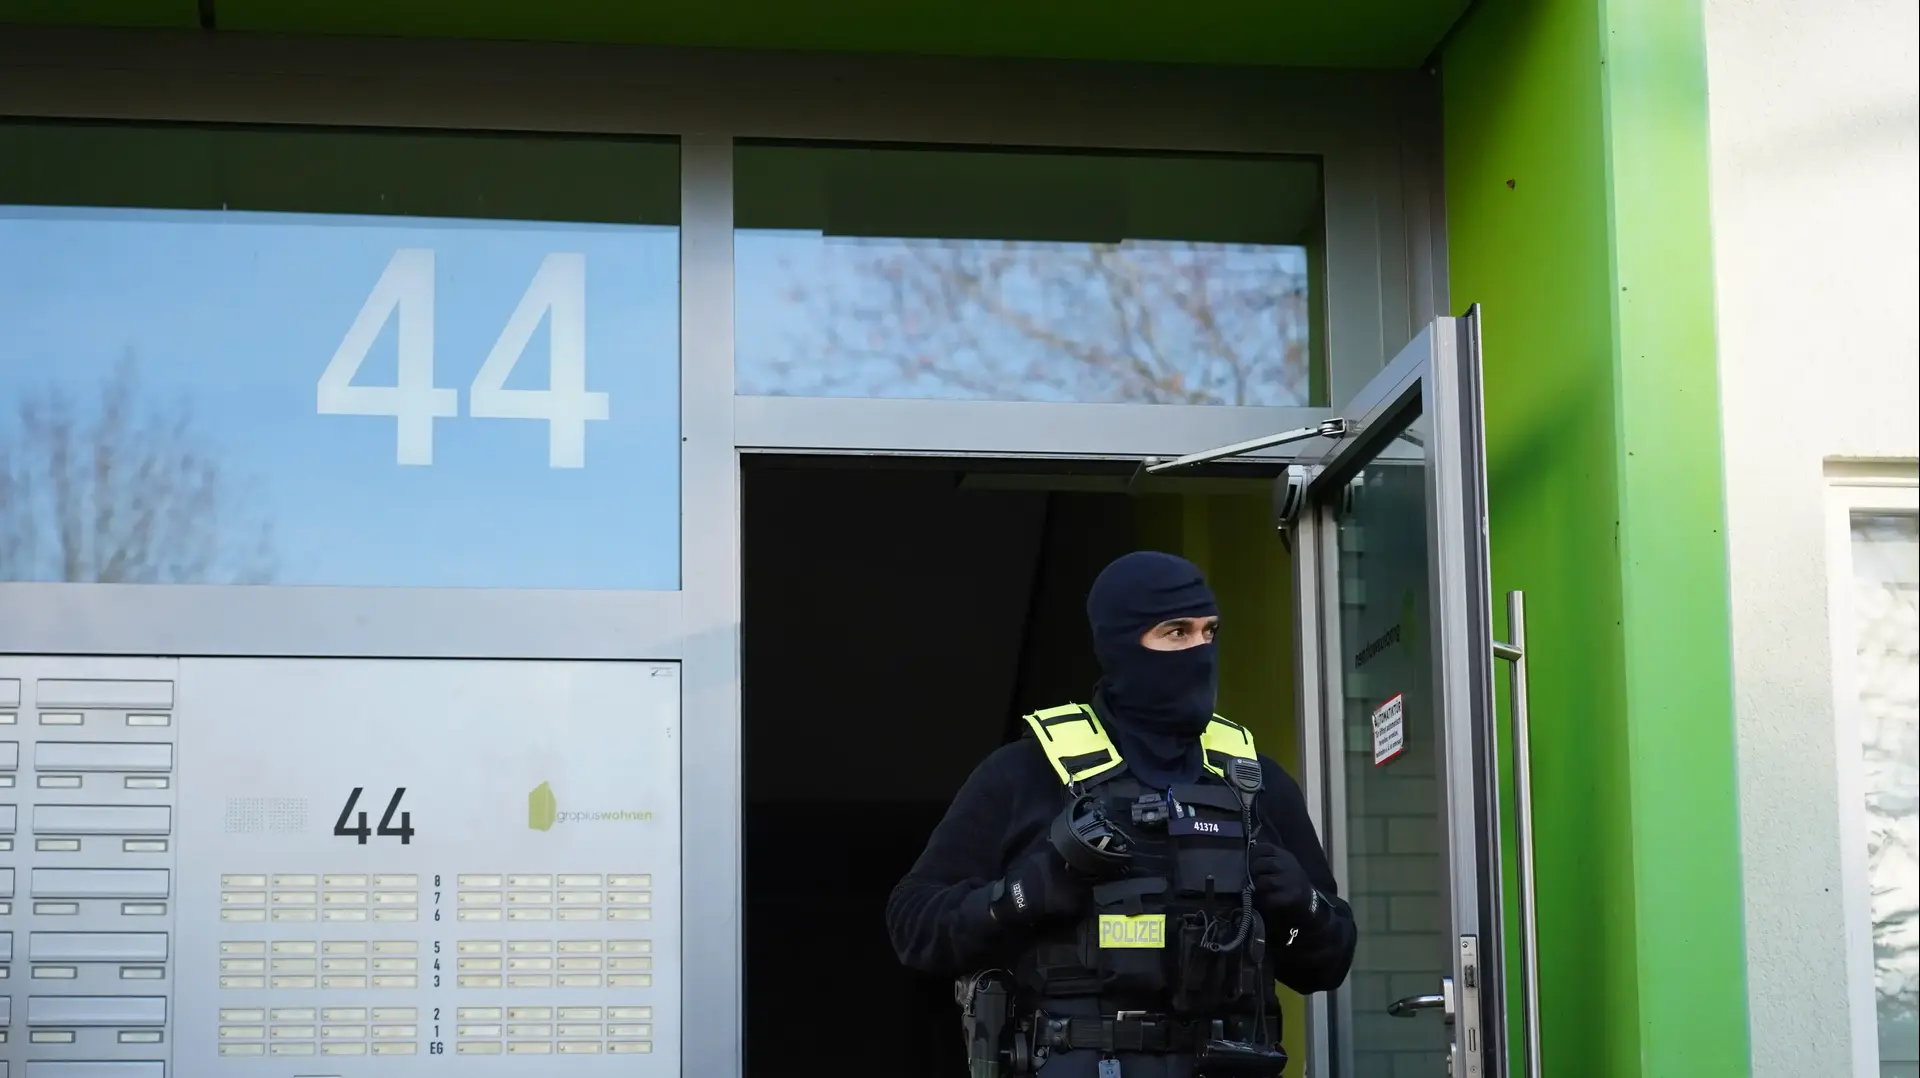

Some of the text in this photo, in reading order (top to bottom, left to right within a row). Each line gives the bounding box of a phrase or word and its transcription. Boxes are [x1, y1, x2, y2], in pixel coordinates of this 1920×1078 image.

[317, 248, 609, 468] 44
[334, 787, 414, 844] 44
[557, 809, 652, 823] gropiuswohnen
[1194, 821, 1219, 833] 41374
[434, 874, 441, 887] 8
[434, 891, 441, 904] 7
[1012, 882, 1026, 909] POLIZEI
[434, 908, 441, 922] 6
[1102, 920, 1162, 943] POLIZEI
[434, 940, 441, 953] 5
[433, 957, 441, 971] 4
[433, 974, 440, 987] 3
[433, 1007, 440, 1020] 2
[434, 1024, 439, 1037] 1
[429, 1041, 443, 1054] EG
